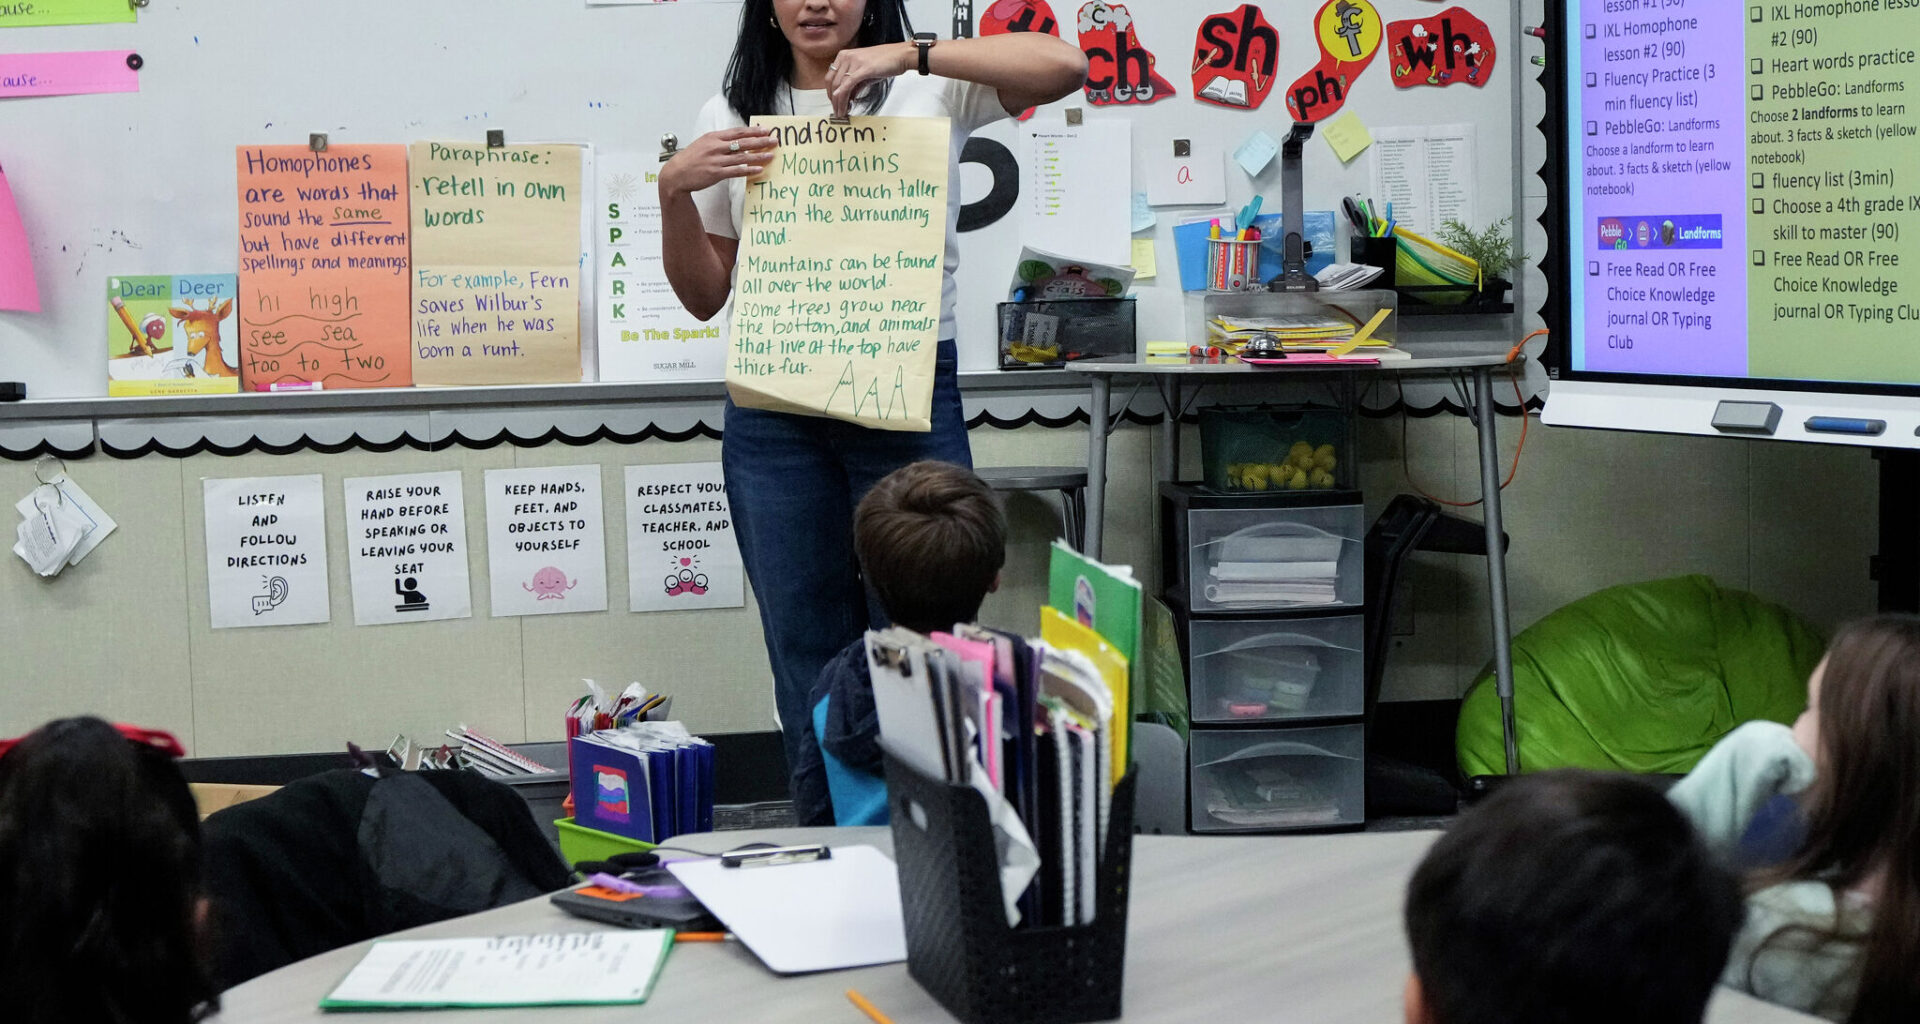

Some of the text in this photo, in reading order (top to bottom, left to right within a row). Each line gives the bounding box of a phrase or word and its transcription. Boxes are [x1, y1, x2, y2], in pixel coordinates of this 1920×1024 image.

[1772, 0, 1920, 20] IXL Homophone lesso
[1604, 18, 1698, 38] IXL Homophone
[1198, 6, 1277, 75] sh
[1401, 18, 1474, 72] wh
[1605, 40, 1685, 62] lesson #2 (90)
[1773, 48, 1915, 73] Heart words practice
[1086, 31, 1151, 91] ch
[1605, 64, 1715, 86] Fluency Practice (3
[1296, 70, 1343, 120] ph
[1773, 80, 1904, 100] PebbleGo: Landforms
[1605, 90, 1698, 111] min fluency list)
[757, 118, 887, 148] andform:
[1606, 118, 1720, 135] PebbleGo: Landforms
[246, 150, 372, 178] Homophones
[430, 143, 552, 166] Paraphrase:
[782, 150, 900, 176] Mountains
[1752, 150, 1805, 165] notebook)
[1177, 166, 1192, 184] a
[1773, 169, 1894, 190] fluency list (3min)
[246, 182, 399, 203] are words that
[423, 176, 565, 202] retell in own
[754, 179, 939, 207] They are much taller
[1588, 182, 1634, 196] notebook)
[297, 209, 324, 226] the
[333, 206, 382, 220] same
[425, 208, 484, 227] words
[750, 205, 796, 223] than
[805, 204, 834, 223] the
[750, 227, 792, 246] land.
[1601, 224, 1622, 237] Pebble
[1679, 226, 1721, 239] Landforms
[242, 231, 406, 253] but have different
[1615, 238, 1627, 250] Go
[242, 254, 305, 276] spellings
[312, 256, 340, 269] and
[748, 251, 937, 274] Mountains can be found
[1774, 250, 1899, 266] Free Read OR Free
[121, 280, 224, 297] Dear Deer
[419, 270, 569, 290] For example, Fern
[742, 274, 893, 294] all over the world.
[1774, 277, 1898, 296] Choice Knowledge
[258, 286, 358, 316] hi high
[418, 292, 542, 314] saves Wilbur's
[1608, 287, 1715, 305] Choice Knowledge
[788, 299, 830, 315] trees
[840, 301, 883, 318] grow
[892, 300, 926, 313] near
[1773, 303, 1920, 323] journal OR Typing Clu
[417, 315, 555, 337] life when he was
[1608, 311, 1712, 330] journal OR Typing
[249, 325, 357, 347] see sea
[621, 326, 720, 342] Be The Spark!
[1608, 335, 1633, 349] Club
[418, 340, 524, 359] born a runt.
[735, 336, 921, 359] that live at the top have
[248, 348, 384, 375] too to two
[734, 358, 812, 376] thick fur.
[366, 486, 441, 501] RAISE YOUR
[505, 482, 585, 495] KEEP HANDS,
[638, 484, 692, 497] RESPECT
[361, 503, 449, 520] HAND BEFORE
[514, 501, 578, 515] FEET, AND
[644, 501, 727, 514] CLASSMATES,
[252, 515, 278, 527] AND
[508, 520, 586, 534] OBJECTS TO
[642, 520, 729, 533] TEACHER, AND
[365, 523, 448, 539] SPEAKING OR
[241, 535, 296, 547] FOLLOW
[361, 542, 455, 557] LEAVING YOUR
[515, 539, 580, 552] YOURSELF
[663, 539, 710, 551] SCHOOL
[227, 554, 307, 568] DIRECTIONS
[394, 563, 424, 574] SEAT
